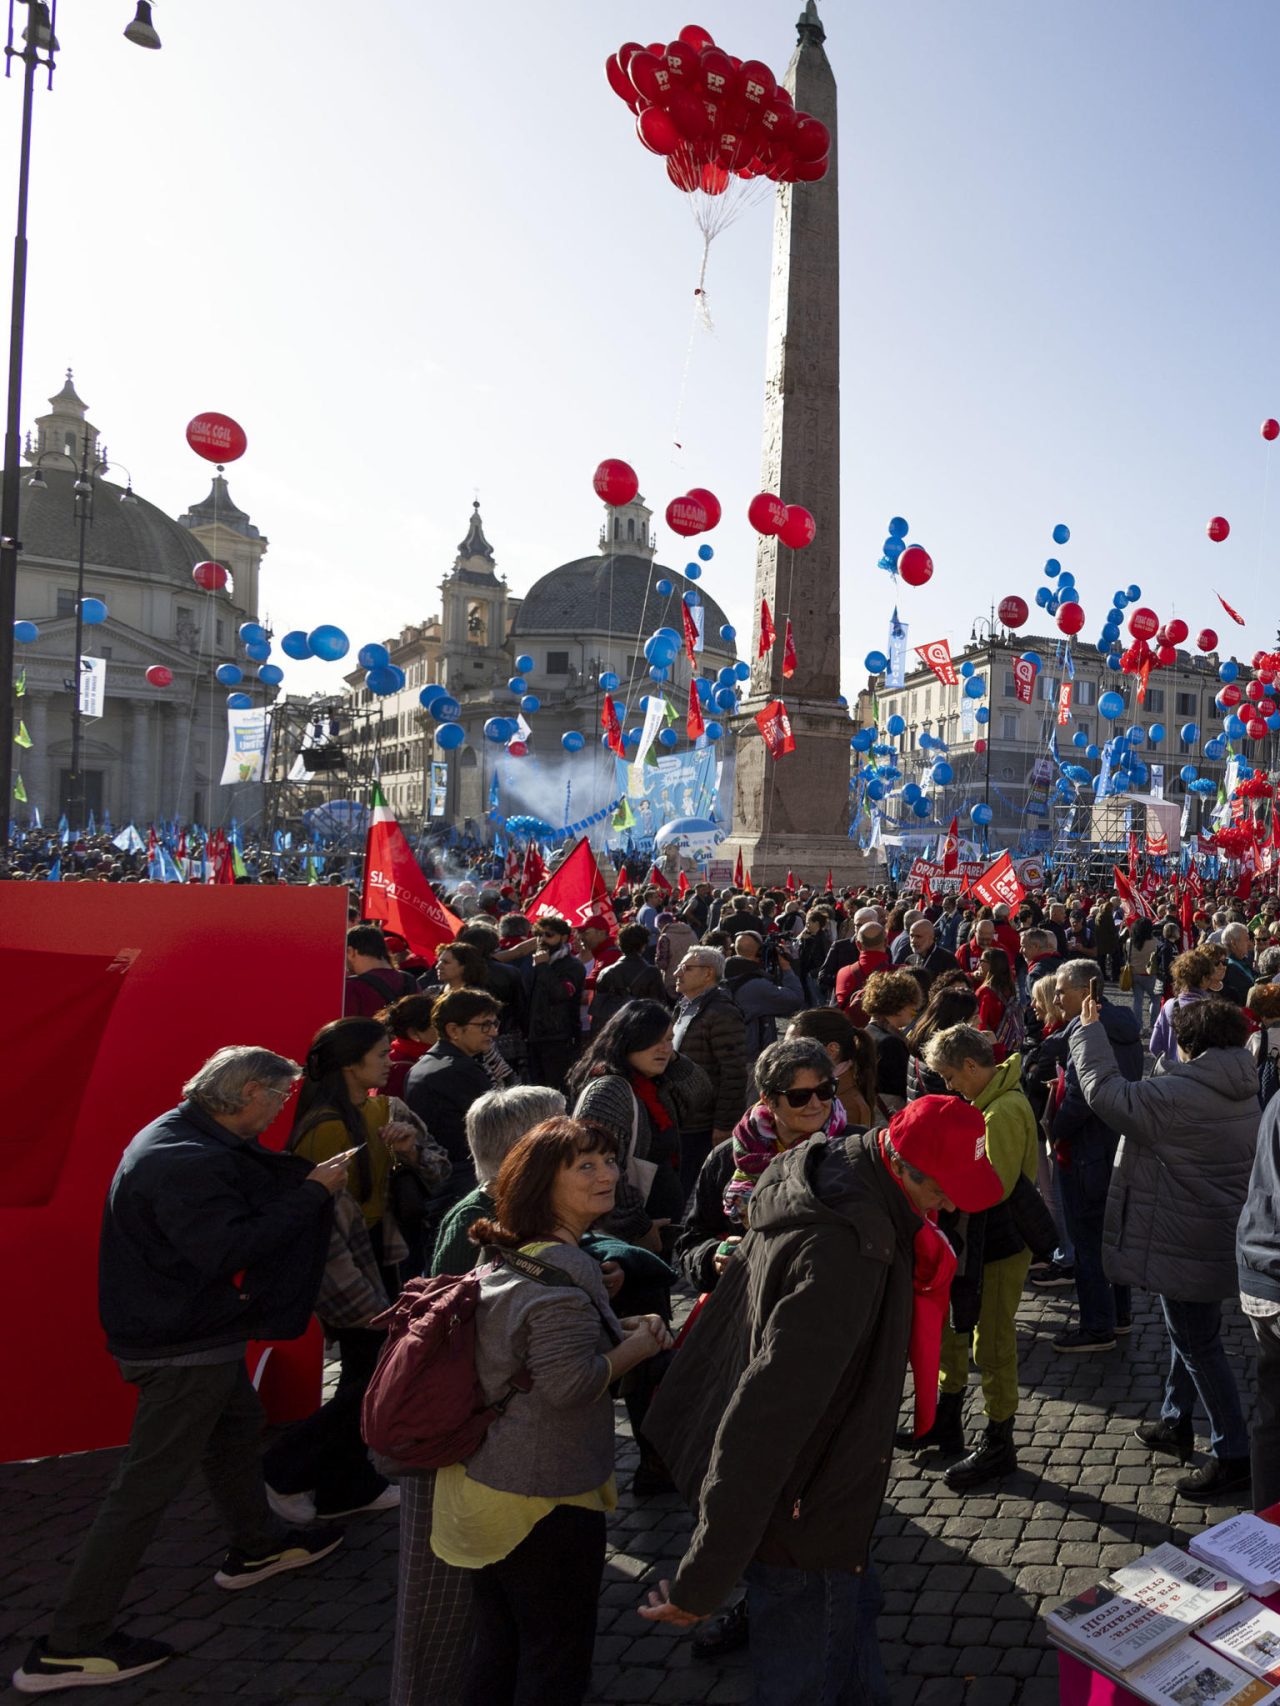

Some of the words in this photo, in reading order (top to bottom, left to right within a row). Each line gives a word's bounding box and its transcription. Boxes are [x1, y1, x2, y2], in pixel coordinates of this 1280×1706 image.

[707, 72, 725, 86] FP
[747, 80, 765, 96] FP
[945, 666, 956, 683] FILT
[1022, 684, 1031, 702] FILT
[1103, 703, 1118, 711] UIL
[701, 852, 713, 860] UIL
[915, 862, 933, 876] ORA
[976, 884, 993, 903] ROMA
[996, 881, 1017, 903] CGIL
[1133, 1577, 1165, 1600] crisi
[1158, 1580, 1182, 1598] tra
[1169, 1593, 1181, 1603] a
[1188, 1591, 1212, 1613] LA
[1079, 1604, 1121, 1633] crolli
[1085, 1594, 1157, 1642] speranze,
[1108, 1601, 1170, 1643] sinistra:
[1131, 1609, 1189, 1651] COMUNE
